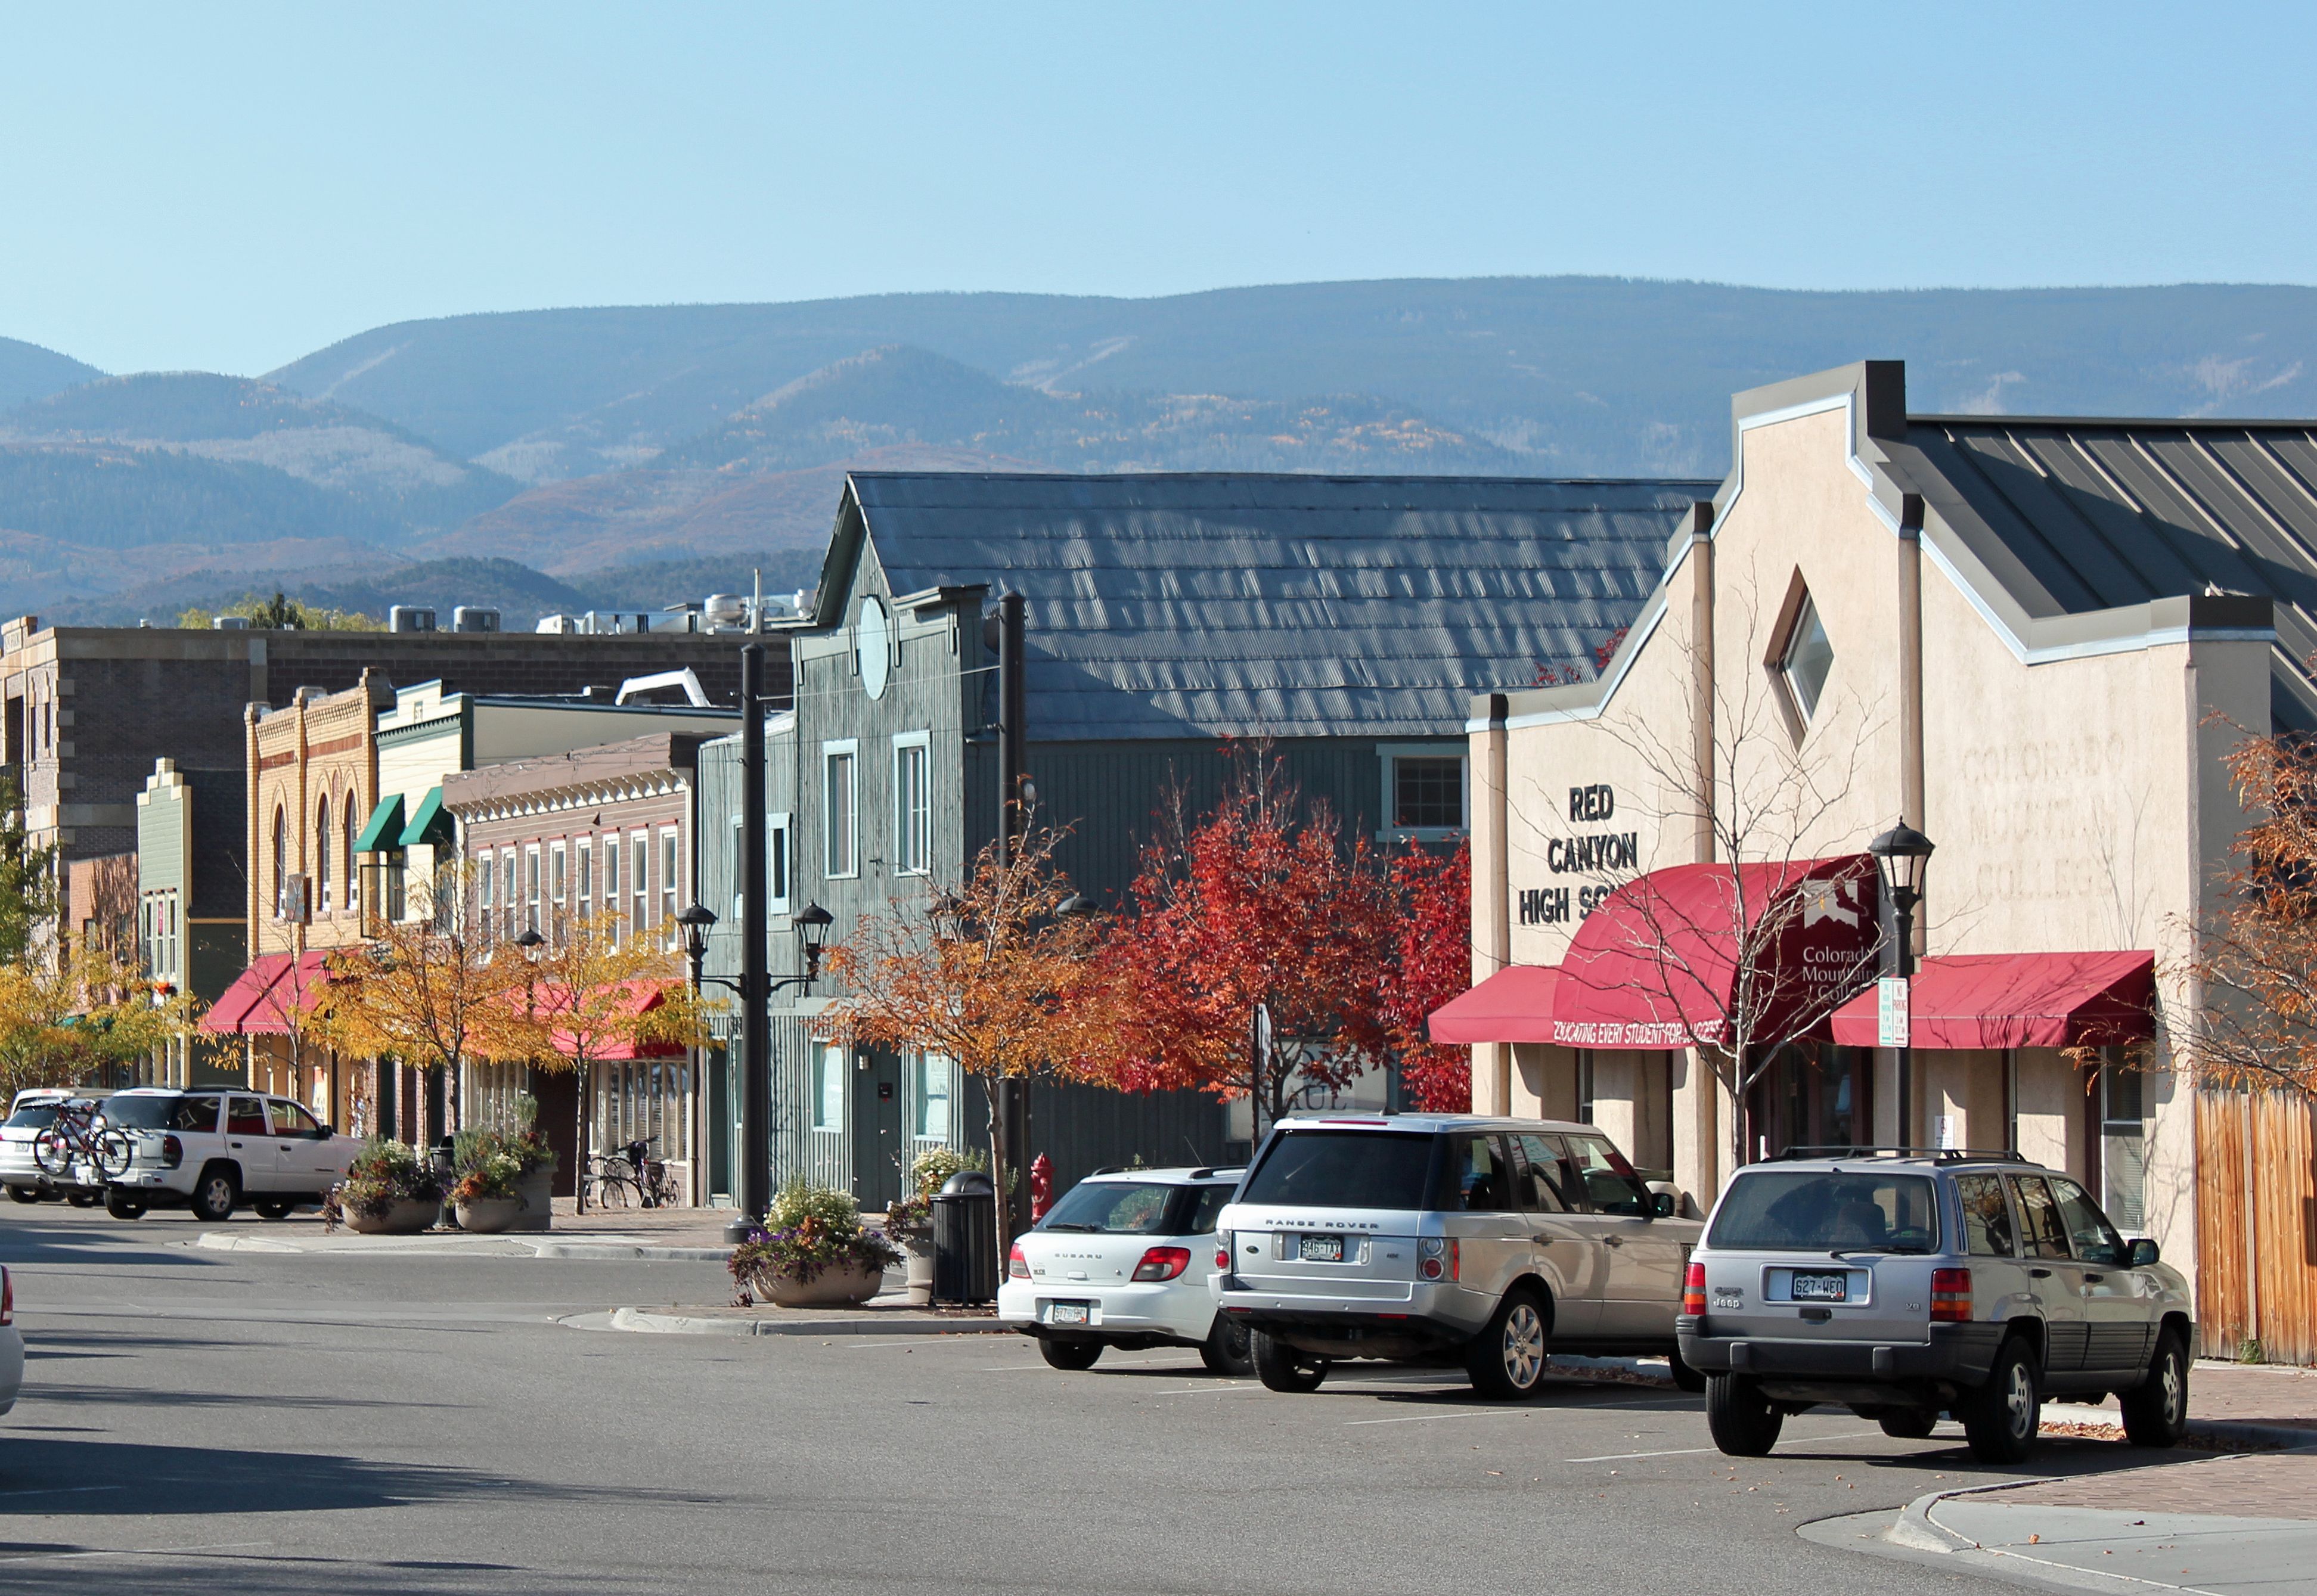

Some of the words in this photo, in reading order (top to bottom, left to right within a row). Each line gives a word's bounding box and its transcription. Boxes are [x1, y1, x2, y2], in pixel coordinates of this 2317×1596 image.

[1570, 784, 1614, 822] RED
[1547, 832, 1637, 874] CANYON
[1519, 887, 1570, 926] HIGH
[1803, 945, 1874, 963] Colorado
[1803, 966, 1874, 982] Mountain
[1598, 1023, 1625, 1044] EVERY
[1624, 1022, 1664, 1044] STUDENT
[1664, 1023, 1682, 1044] FOR
[1325, 1221, 1379, 1229] ROVER
[1713, 1298, 1740, 1309] Jeep
